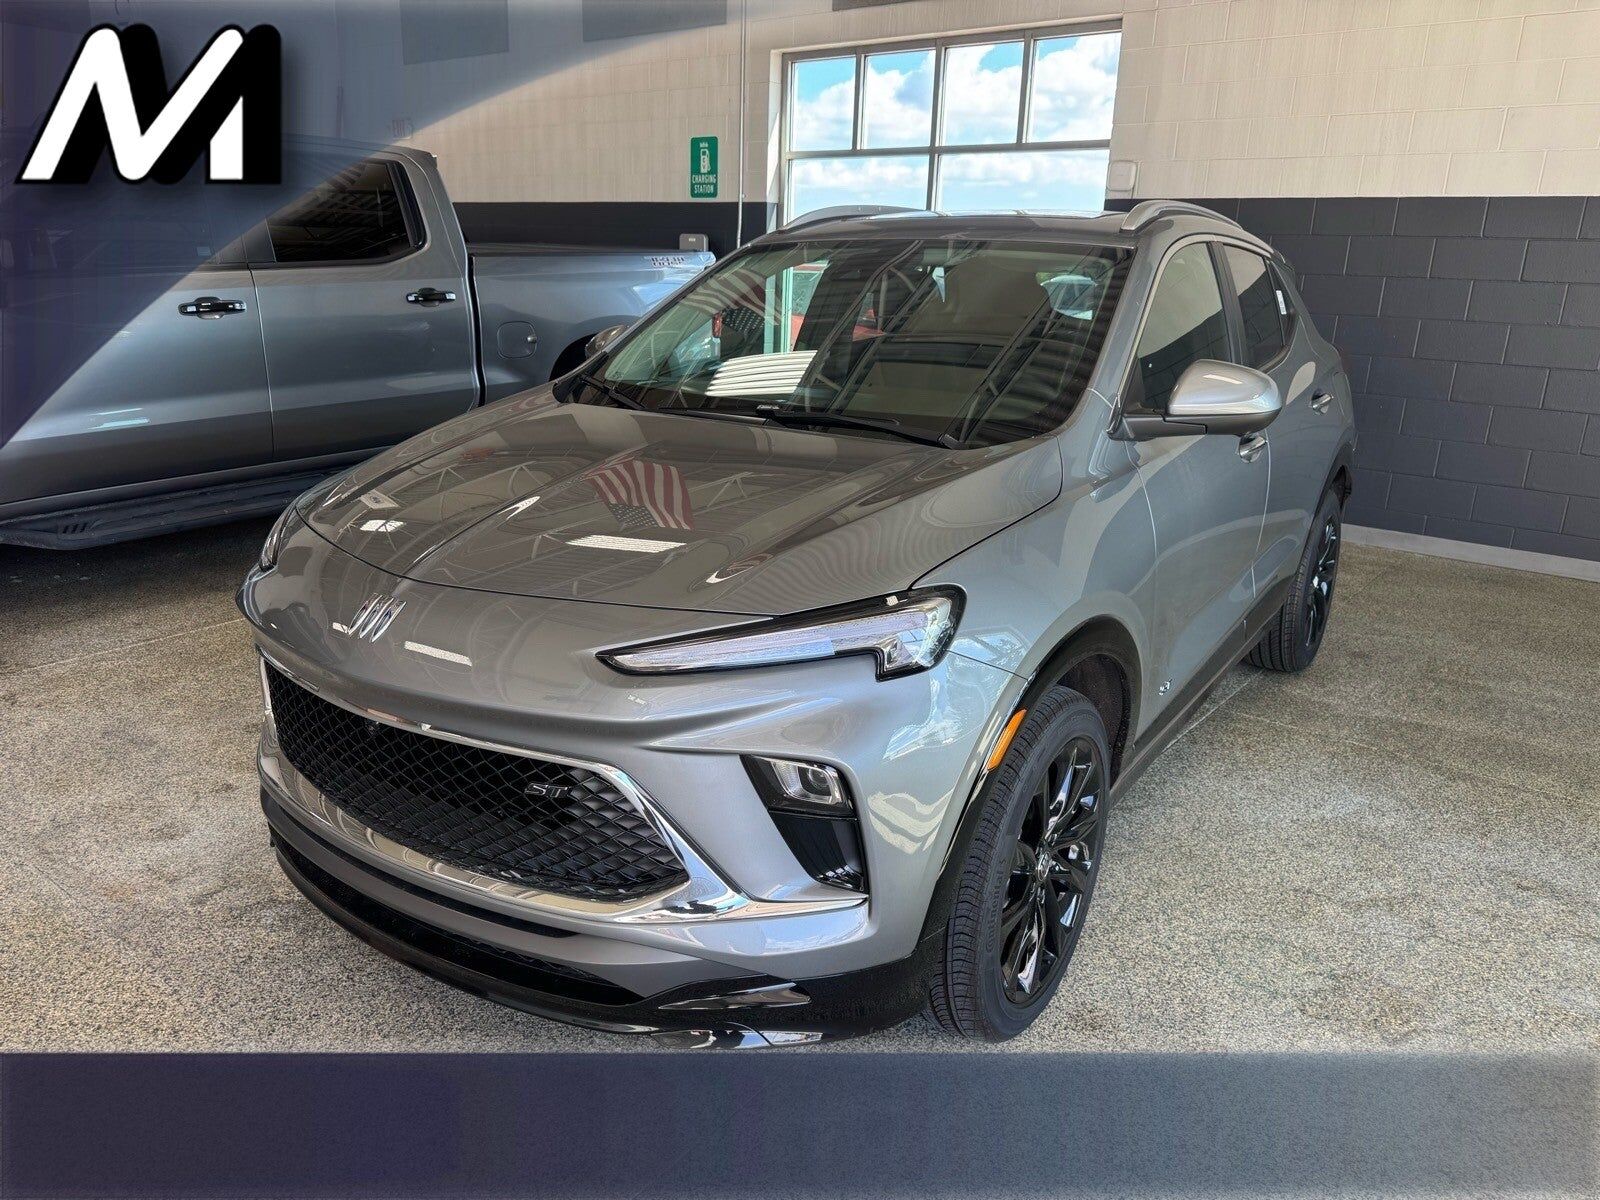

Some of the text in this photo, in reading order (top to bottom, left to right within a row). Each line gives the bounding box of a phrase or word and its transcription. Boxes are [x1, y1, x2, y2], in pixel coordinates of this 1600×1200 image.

[692, 174, 717, 183] CHARGING
[694, 184, 714, 193] STATION
[524, 781, 569, 798] ST
